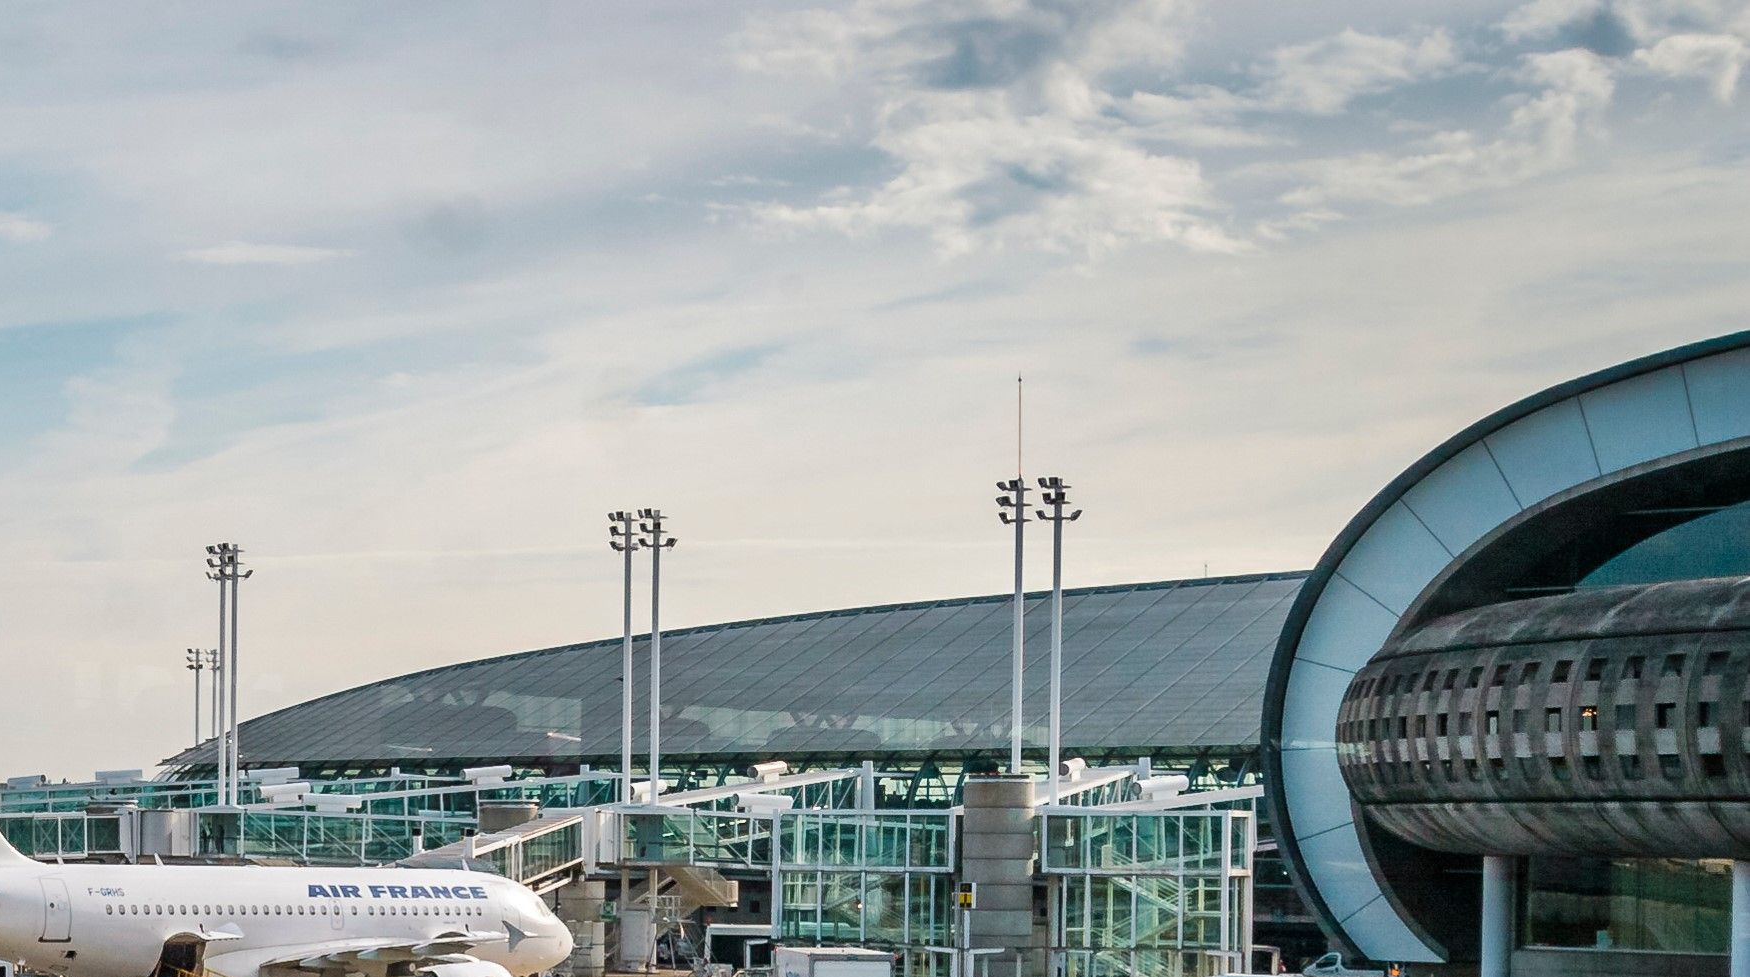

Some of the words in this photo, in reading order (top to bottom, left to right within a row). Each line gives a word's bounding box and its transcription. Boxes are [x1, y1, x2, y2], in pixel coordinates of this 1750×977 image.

[87, 887, 125, 897] F-GRHS
[308, 885, 362, 898] AIR
[368, 885, 488, 899] FRANCE
